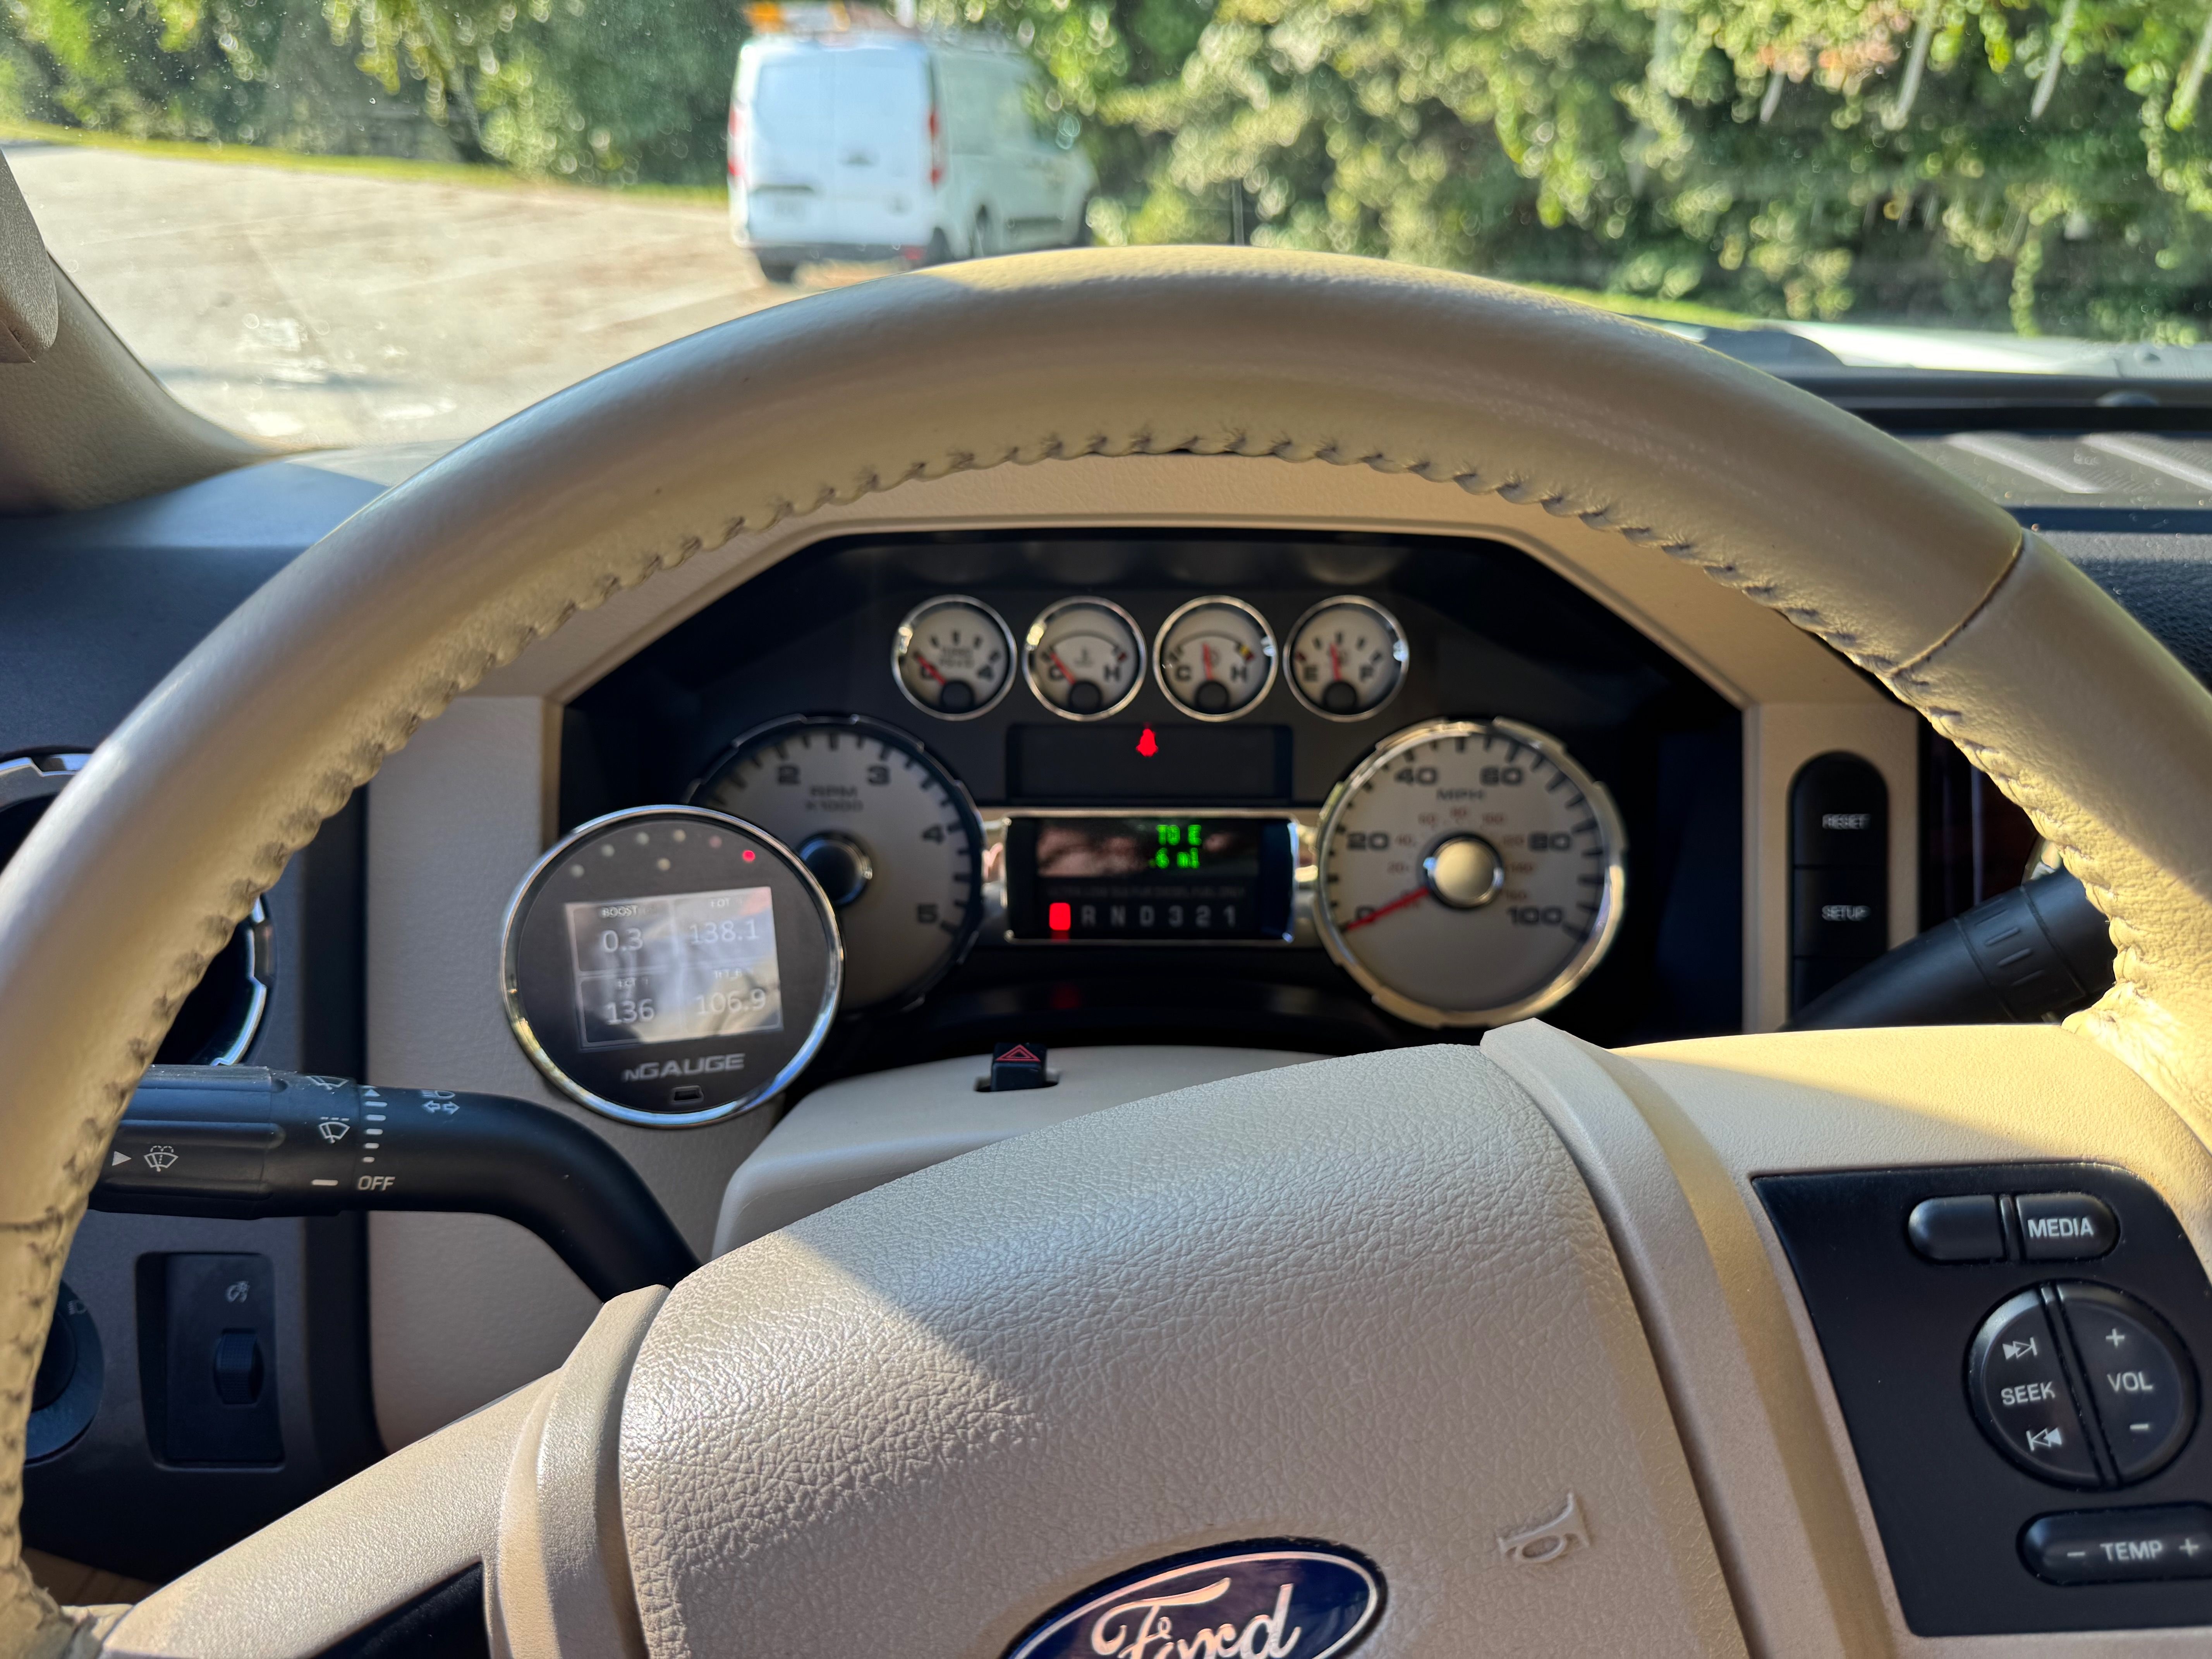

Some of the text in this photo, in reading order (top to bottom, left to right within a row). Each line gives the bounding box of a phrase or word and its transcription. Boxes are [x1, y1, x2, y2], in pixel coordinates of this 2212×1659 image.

[1104, 665, 1120, 681] H
[1176, 666, 1192, 682] C
[1231, 666, 1247, 682] H
[1305, 666, 1318, 681] E
[778, 765, 801, 786] 2
[867, 764, 891, 786] 3
[1395, 768, 1438, 785] 40
[1437, 789, 1485, 800] MPH
[922, 825, 945, 845] 4
[1347, 833, 1390, 850] 20
[601, 905, 638, 919] BOOST
[917, 903, 938, 924] 5
[1081, 905, 1097, 927] R
[1110, 905, 1127, 927] N
[1139, 905, 1155, 927] D
[1169, 905, 1184, 927] 3
[1196, 905, 1211, 927] 2
[1224, 905, 1237, 927] 1
[1508, 906, 1563, 925] 100
[1822, 905, 1871, 921] SETUP
[602, 927, 644, 953] 0.3
[689, 919, 760, 945] 138.1
[606, 998, 655, 1025] 136
[697, 988, 766, 1015] 106.9
[357, 1175, 395, 1192] OFF
[2027, 1217, 2094, 1238] MEDIA
[2107, 1371, 2153, 1393] VOL
[2001, 1381, 2056, 1406] SEEK
[2100, 1539, 2163, 1562] TEMP
